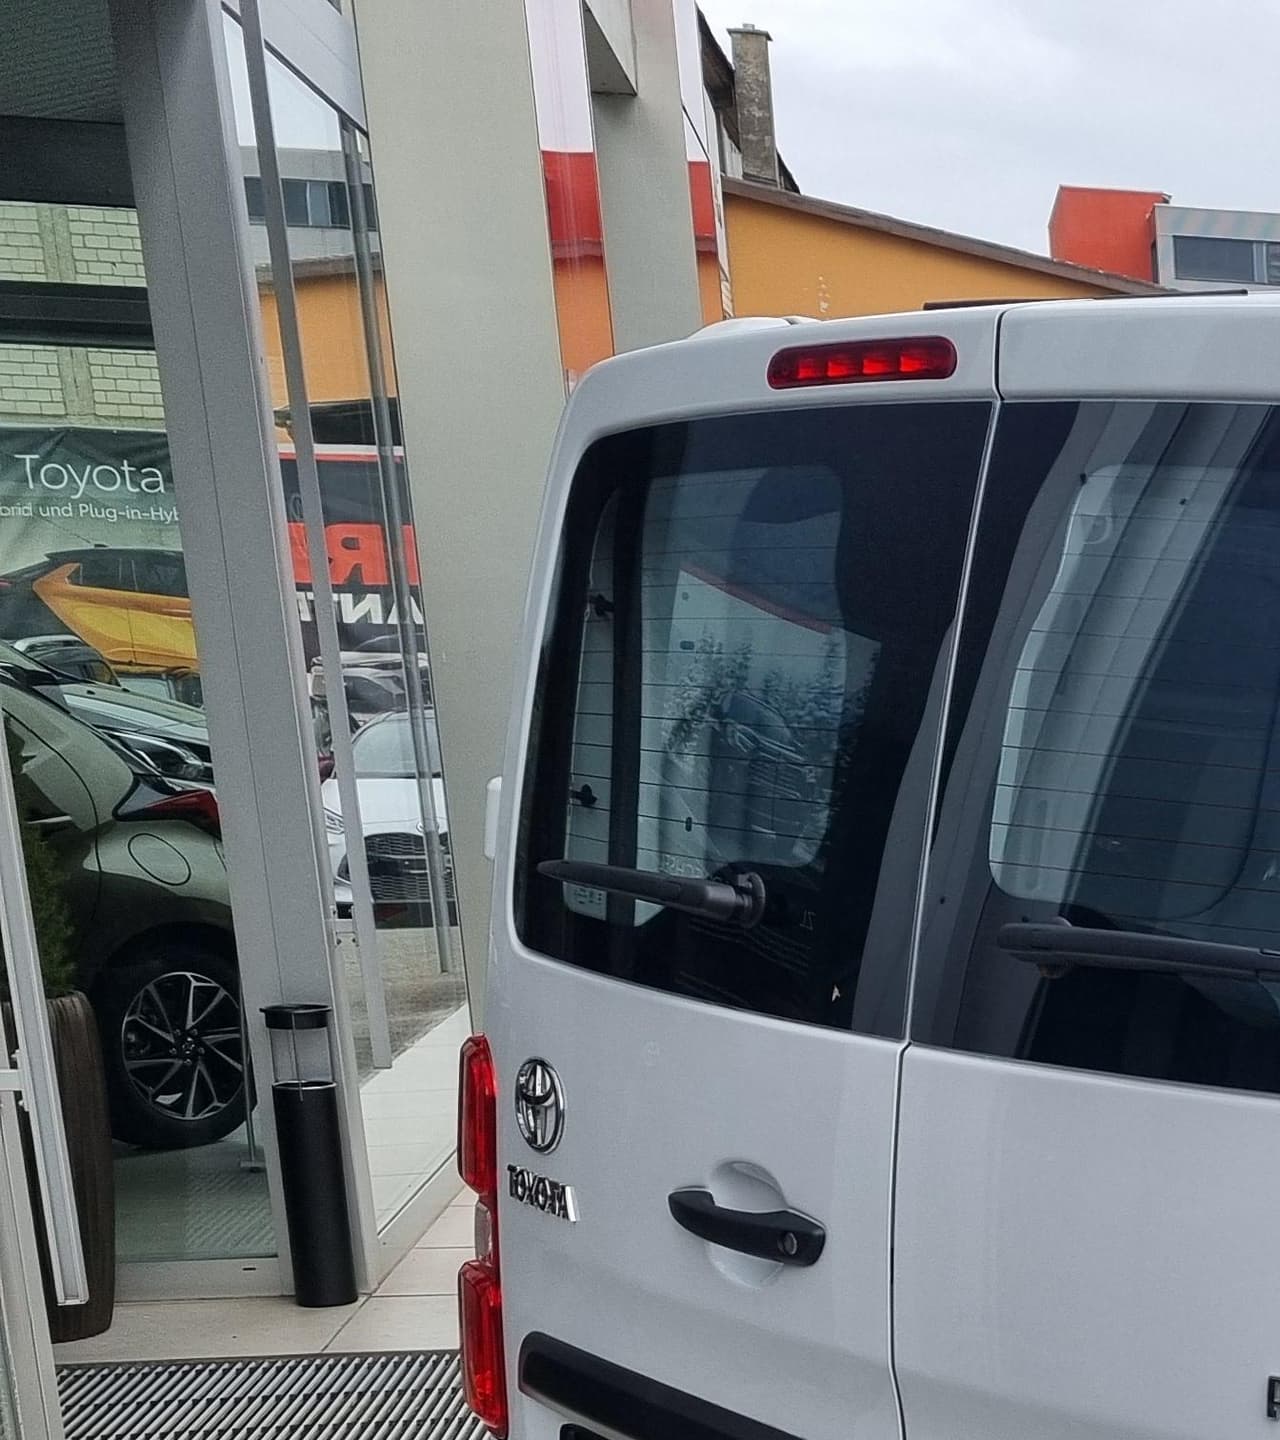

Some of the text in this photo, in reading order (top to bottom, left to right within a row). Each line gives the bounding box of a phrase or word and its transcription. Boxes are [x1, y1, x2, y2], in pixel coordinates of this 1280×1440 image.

[14, 454, 165, 499] Toyota
[39, 502, 73, 518] und
[507, 1164, 581, 1223] TOYOTA
